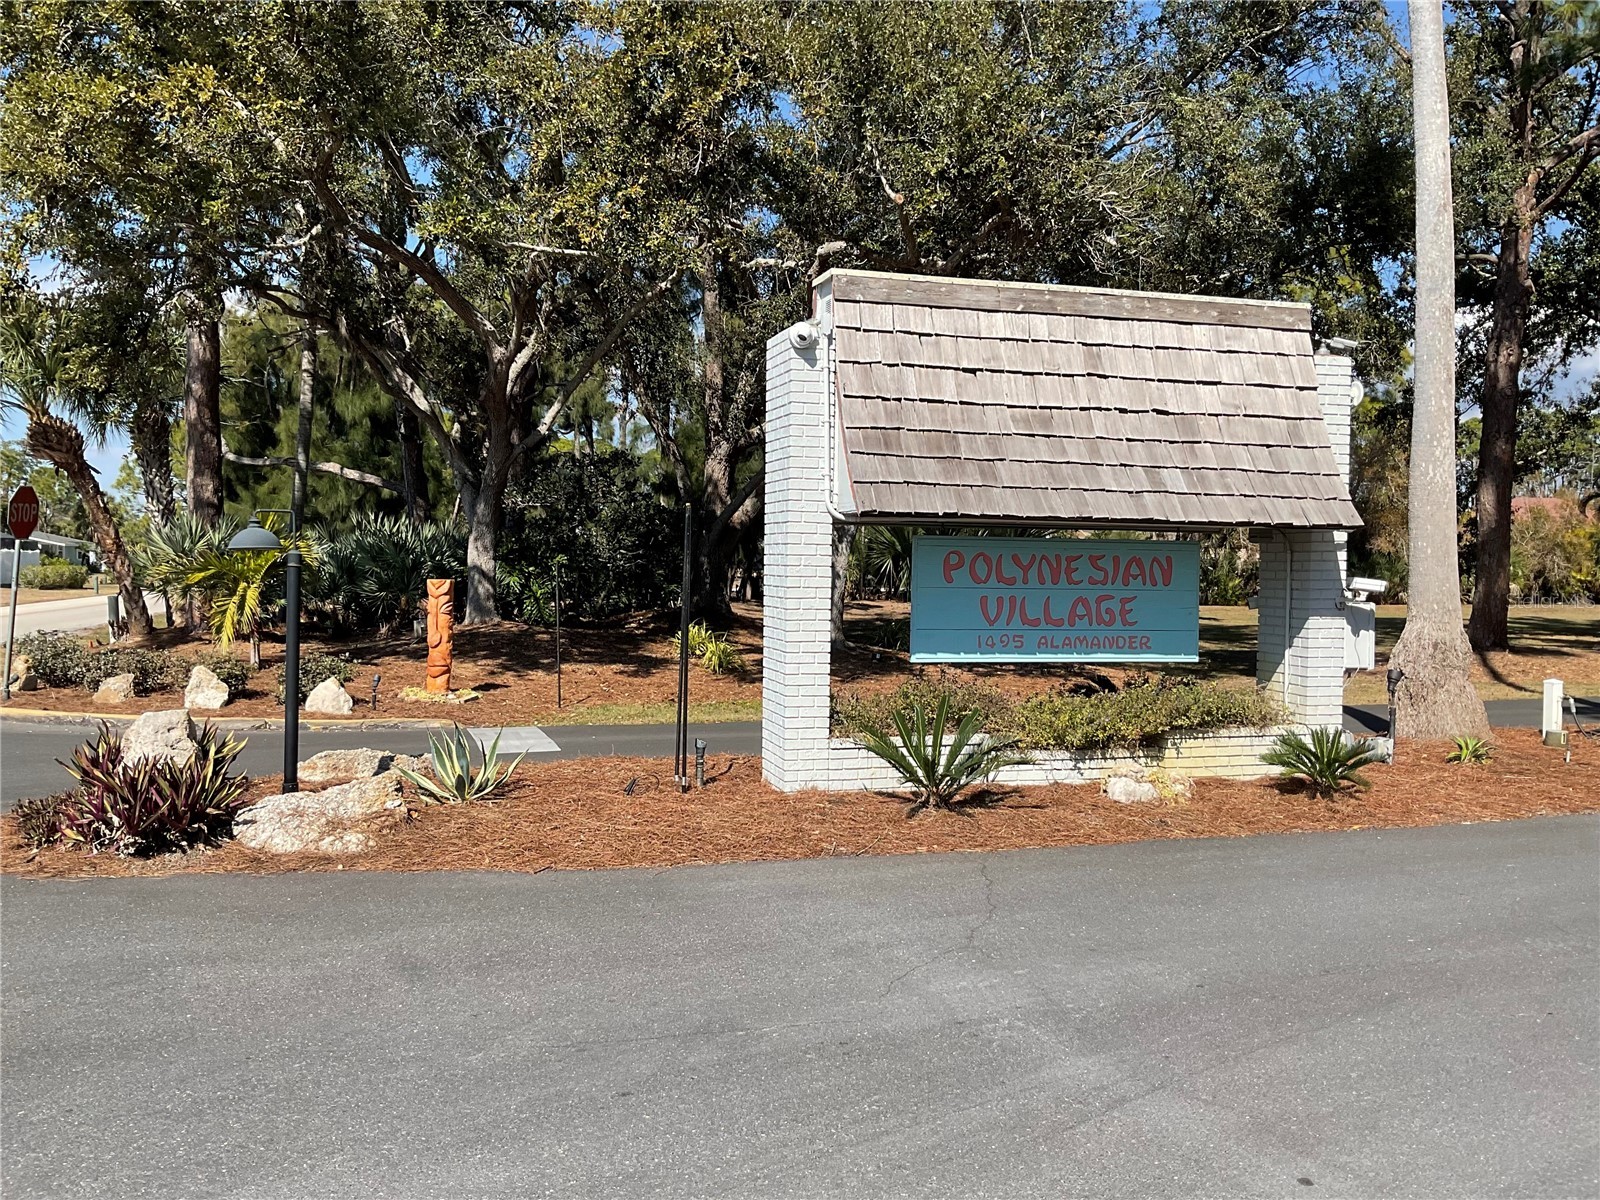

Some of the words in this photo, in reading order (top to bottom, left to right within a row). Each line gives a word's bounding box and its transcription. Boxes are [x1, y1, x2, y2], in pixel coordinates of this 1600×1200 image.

[10, 503, 38, 523] STOP
[942, 550, 1173, 587] POLYNESIAN
[979, 594, 1139, 628] VILLAGE
[977, 633, 1025, 649] 1495
[1037, 634, 1152, 650] ALAMANDER
